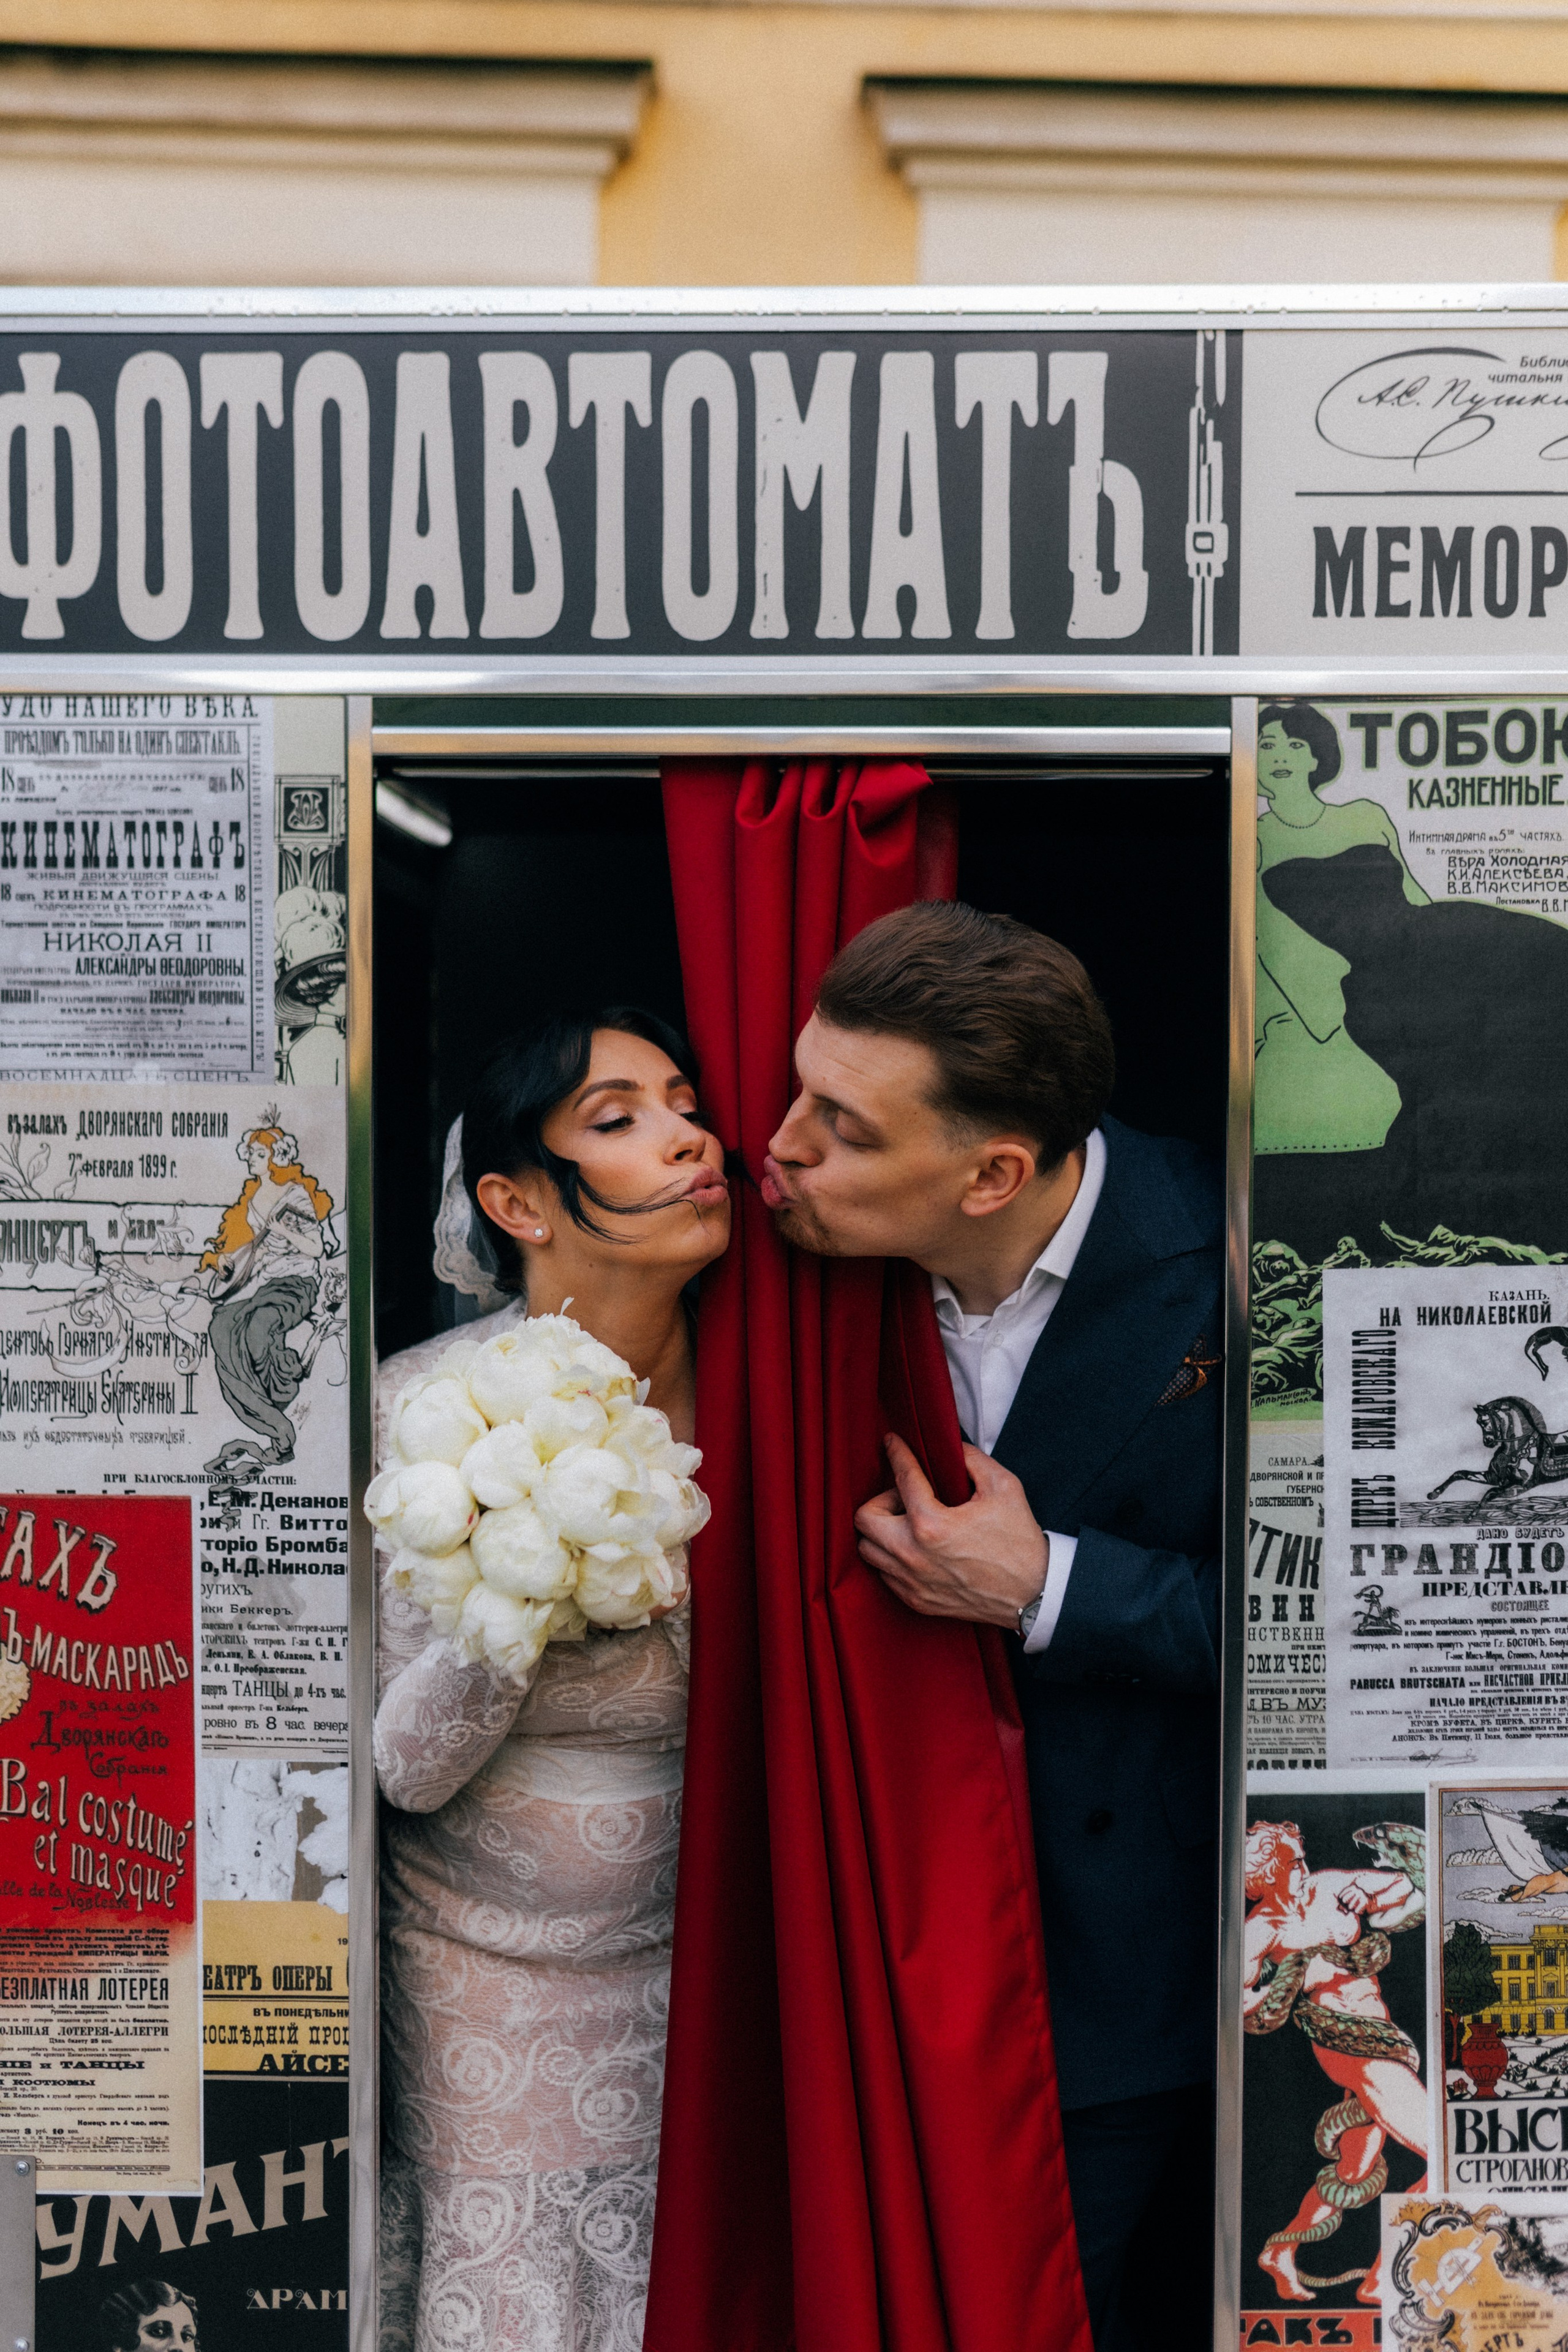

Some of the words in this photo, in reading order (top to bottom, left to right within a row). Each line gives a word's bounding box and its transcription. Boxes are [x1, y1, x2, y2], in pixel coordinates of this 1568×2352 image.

[1520, 355, 1568, 368] Библи
[1488, 374, 1562, 383] читальня
[0, 350, 1149, 641] ФОТОАВТОМАТЪ
[1313, 526, 1568, 619] МЕМОР
[65, 696, 172, 718] НАШЕГО
[73, 731, 115, 755] ТОЛЬКО
[118, 731, 131, 755] НА
[135, 731, 172, 758] ОДИНЪ
[231, 767, 245, 792] 18
[0, 821, 245, 869] КИНЕМАТОГРАФЪ
[42, 890, 227, 901] КИНЕМАТОГРАФА
[235, 884, 245, 902] 18
[43, 932, 183, 952] НИКОЛАЯ
[75, 957, 156, 978] АЛЕКСАНДРЫ
[76, 1110, 163, 1140] ДВОРЯНСКАГО
[172, 1112, 228, 1138] СОБРАНІЯ
[138, 1155, 167, 1178] 1899
[1490, 1289, 1550, 1302] КАЗАНЬ.
[1380, 1307, 1402, 1327] НА
[1417, 1301, 1551, 1326] НИКОЛАЕВСКОЙ
[1352, 1330, 1396, 1450] КОМАРОВСКАГО
[1268, 1457, 1310, 1466] САМАРА.
[104, 1474, 127, 1483] ПРИ
[1250, 1471, 1303, 1482] ДВОРЯНСКОЙ
[1255, 1496, 1314, 1507] СОБСТВЕННОМЪ
[1351, 1475, 1400, 1528] ЦИРКЪ
[1477, 1528, 1509, 1540] ДАНО
[1515, 1527, 1564, 1540] БУДЕТЪ
[268, 1559, 348, 1575] Никола
[230, 1604, 293, 1616] Беккеръ.
[1490, 1599, 1550, 1612] СОСТОЯЩЕЕ
[232, 1680, 288, 1700] ТАНЦЫ
[1261, 1698, 1288, 1711] ВЪ
[204, 1718, 237, 1730] ровно
[245, 1720, 259, 1729] въ
[266, 1716, 277, 1730] 8
[79, 1792, 194, 1867] costumé
[34, 1829, 59, 1875] et
[70, 1842, 185, 1913] masqué
[273, 1966, 333, 1991] ОПЕРЫ
[98, 1978, 169, 2001] ЛОТЕРЕЯ
[253, 2008, 271, 2017] ВЪ
[60, 2060, 145, 2071] ТАНЦЫ
